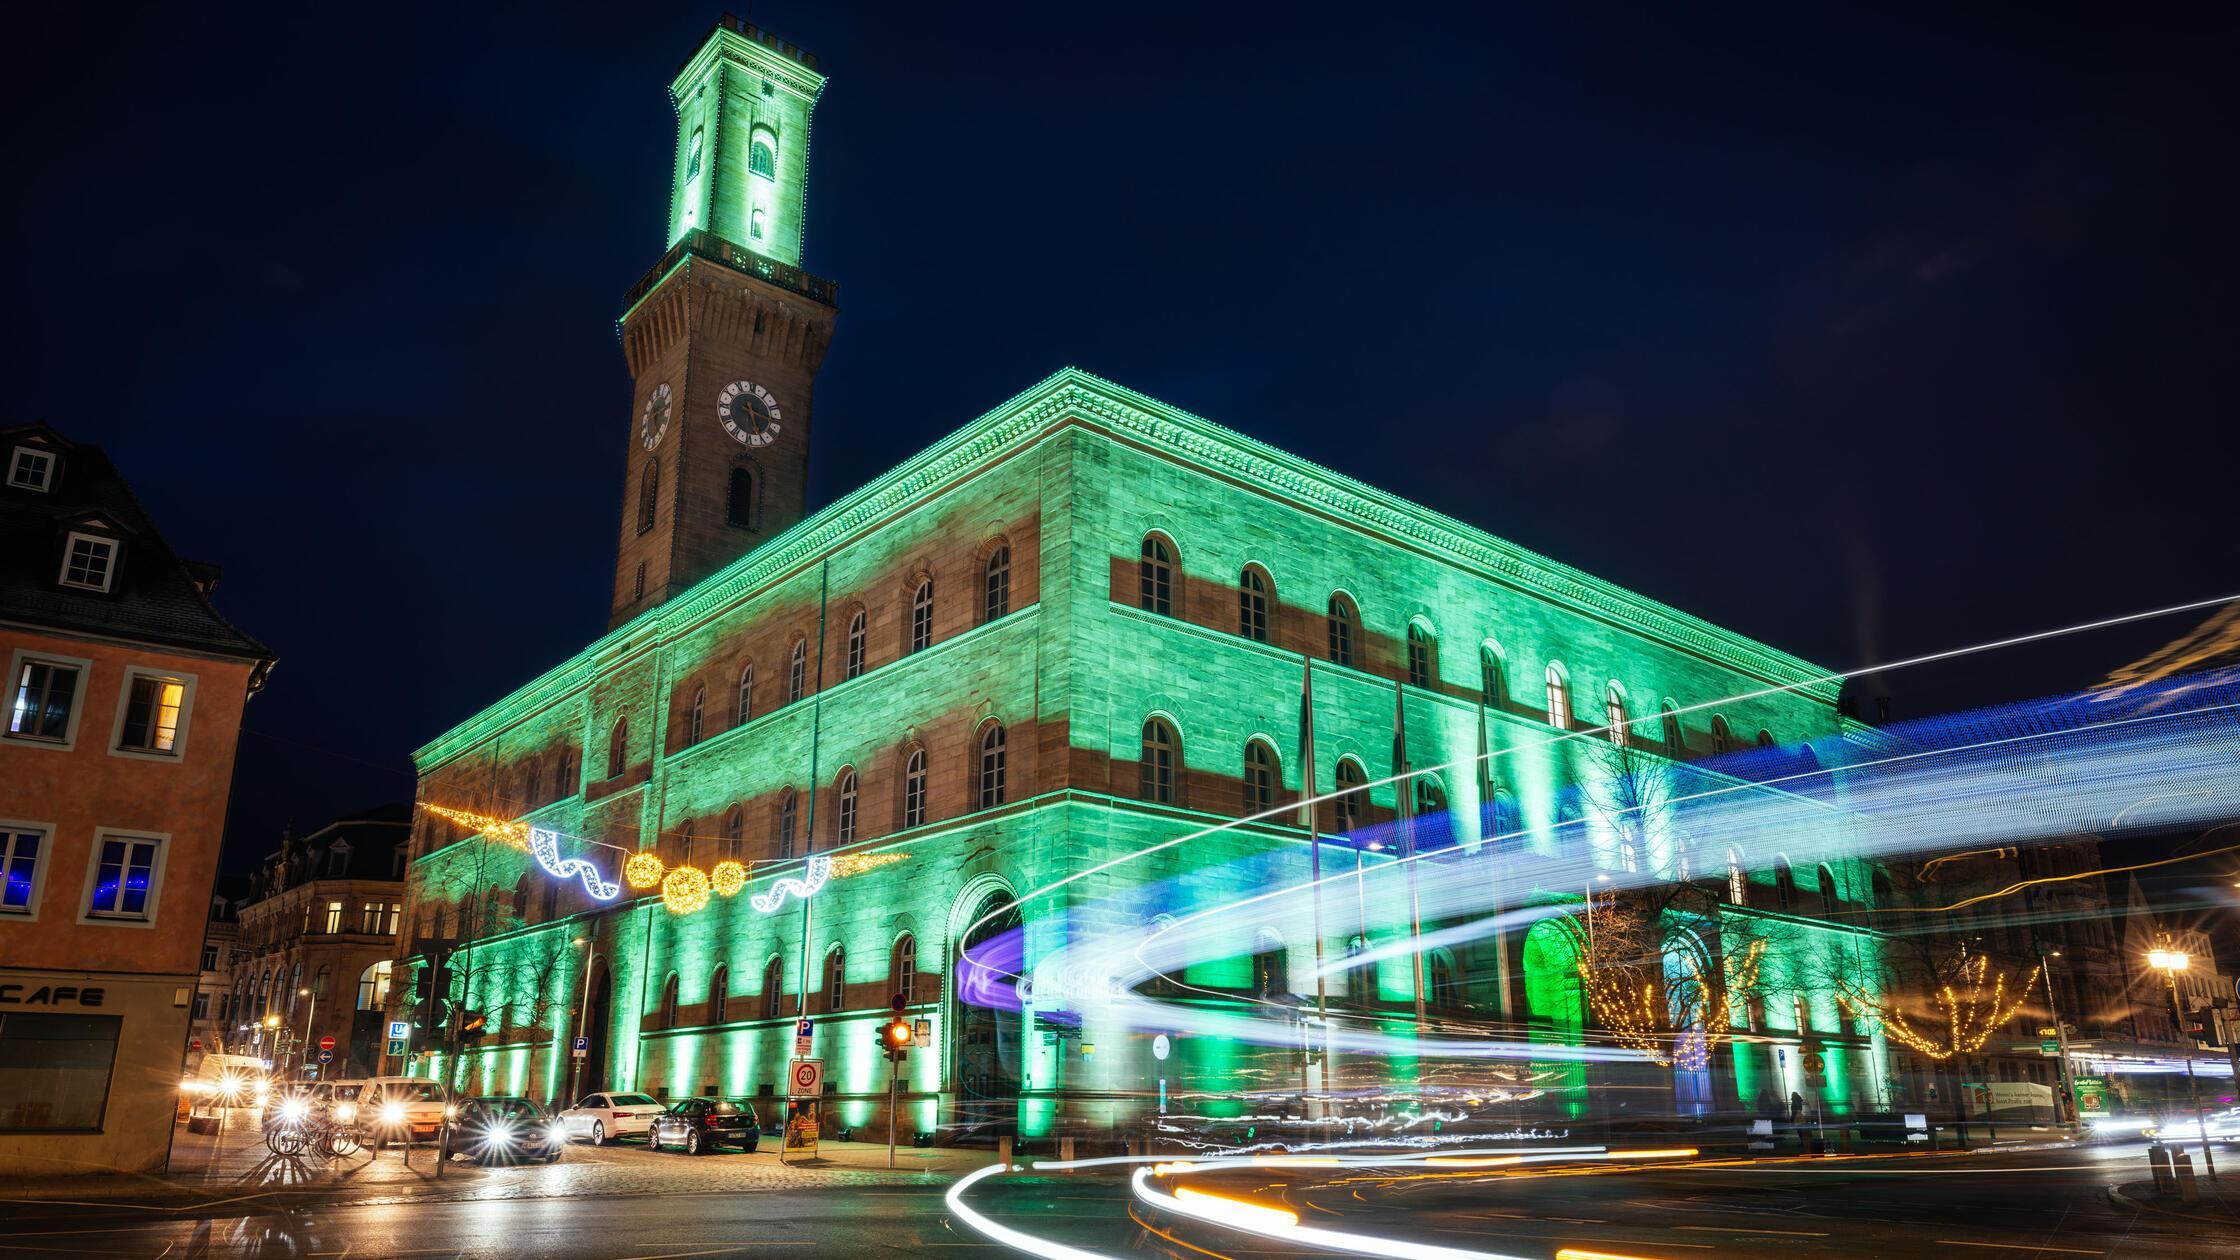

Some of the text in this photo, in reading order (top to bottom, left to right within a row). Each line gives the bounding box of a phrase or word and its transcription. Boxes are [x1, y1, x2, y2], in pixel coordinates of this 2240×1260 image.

[0, 984, 105, 1006] CAFE
[395, 1024, 403, 1034] U
[801, 1021, 810, 1035] P
[576, 1038, 585, 1049] P
[800, 1070, 812, 1081] 20
